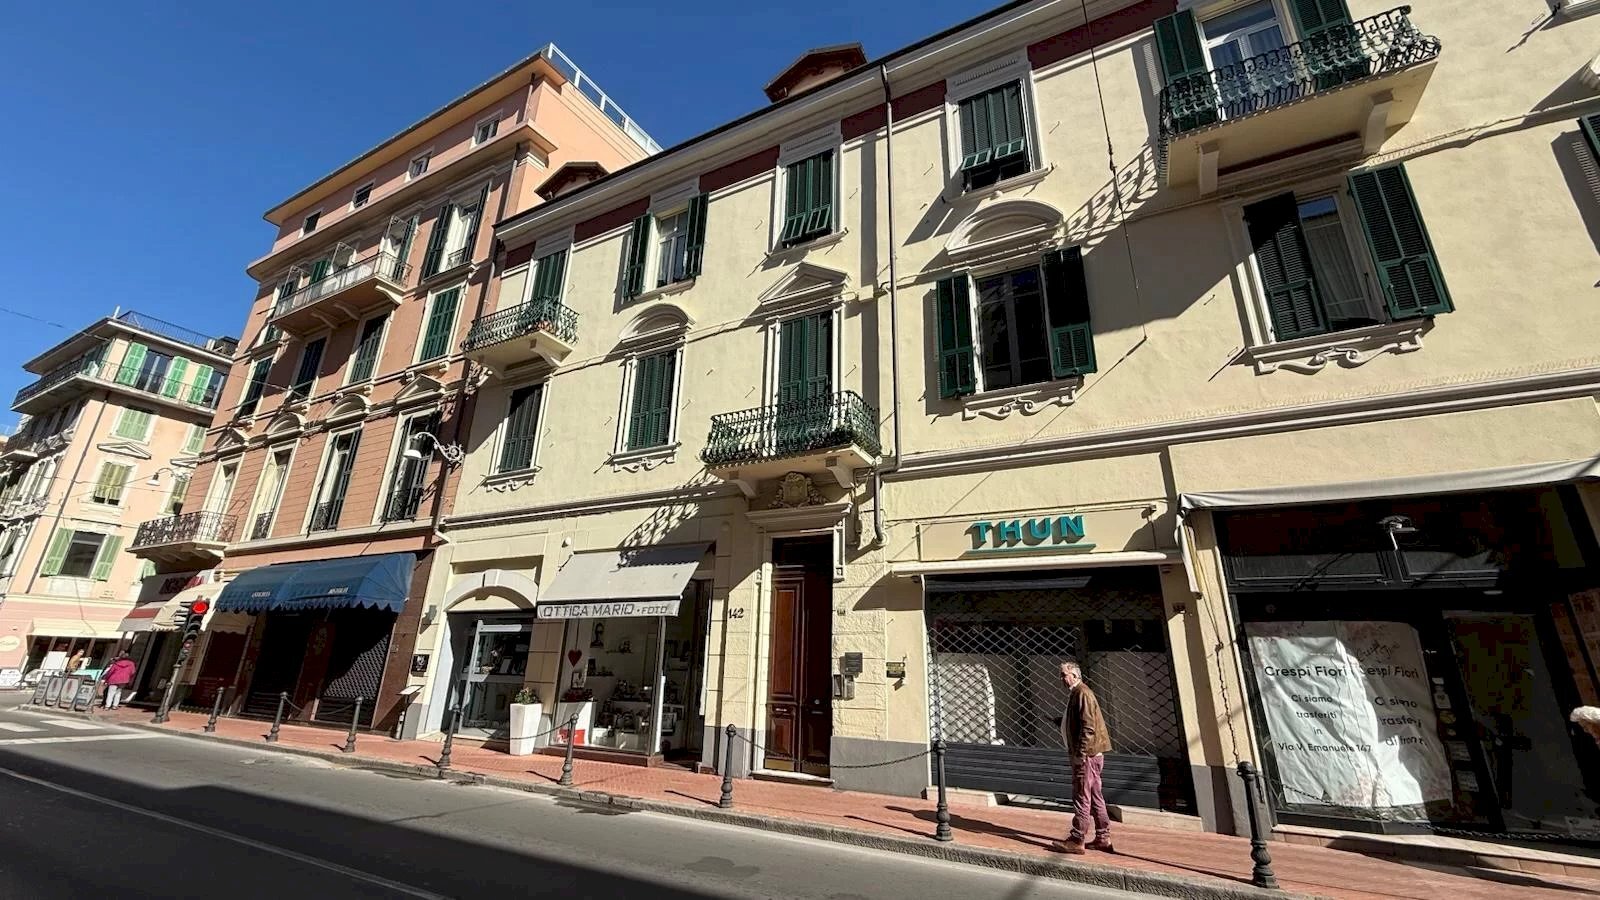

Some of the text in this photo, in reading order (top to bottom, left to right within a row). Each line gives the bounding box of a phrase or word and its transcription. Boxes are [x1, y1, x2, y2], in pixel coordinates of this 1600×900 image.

[972, 515, 1085, 542] THUN
[543, 603, 668, 617] OTTICA MARIO FOTO
[728, 607, 744, 620] 142
[1264, 665, 1348, 679] Crespi Fiori
[1393, 666, 1419, 679] Fiori
[1291, 694, 1333, 703] Ci siamo
[1296, 711, 1338, 719] trasferiti
[1313, 727, 1323, 735] in
[1278, 742, 1294, 751] Via
[1307, 743, 1355, 752] Emanuele
